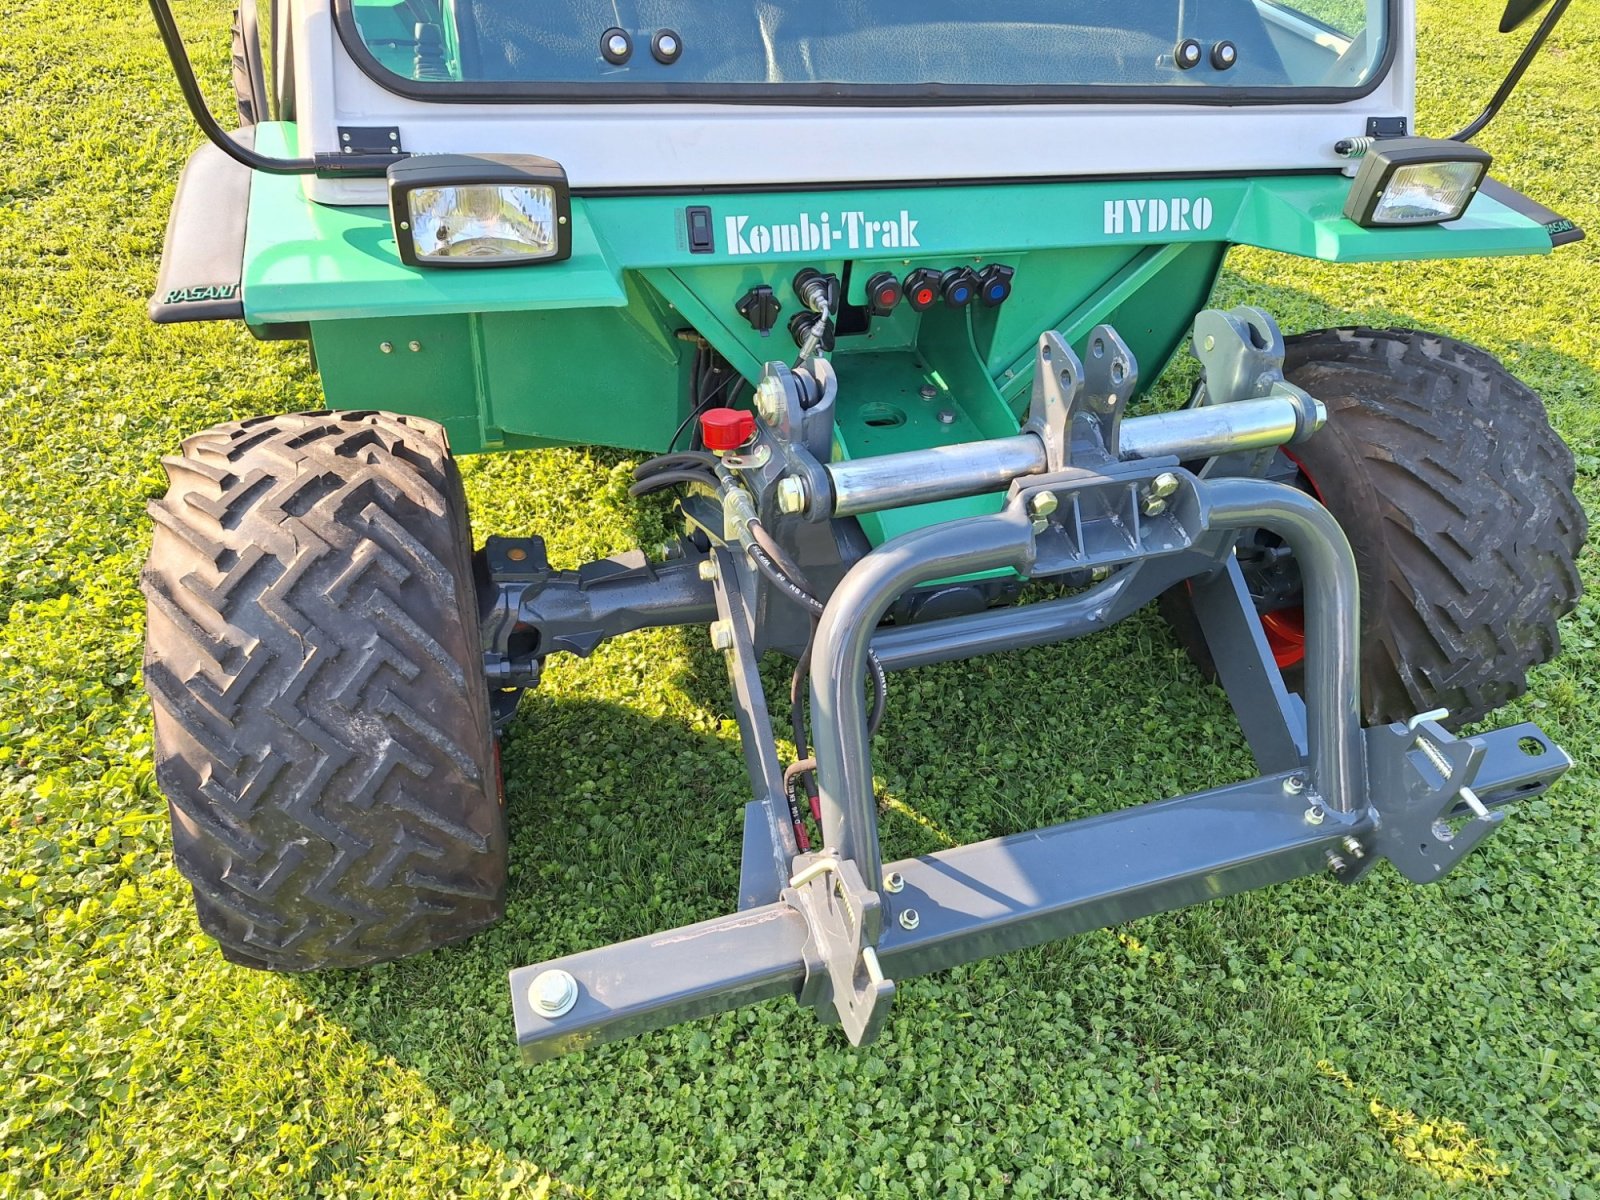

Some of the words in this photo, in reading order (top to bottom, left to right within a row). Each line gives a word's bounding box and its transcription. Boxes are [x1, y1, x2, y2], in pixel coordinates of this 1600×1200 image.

[725, 210, 920, 255] Kombi-Trak
[1103, 197, 1213, 234] HYDRO
[164, 283, 240, 304] RASANT
